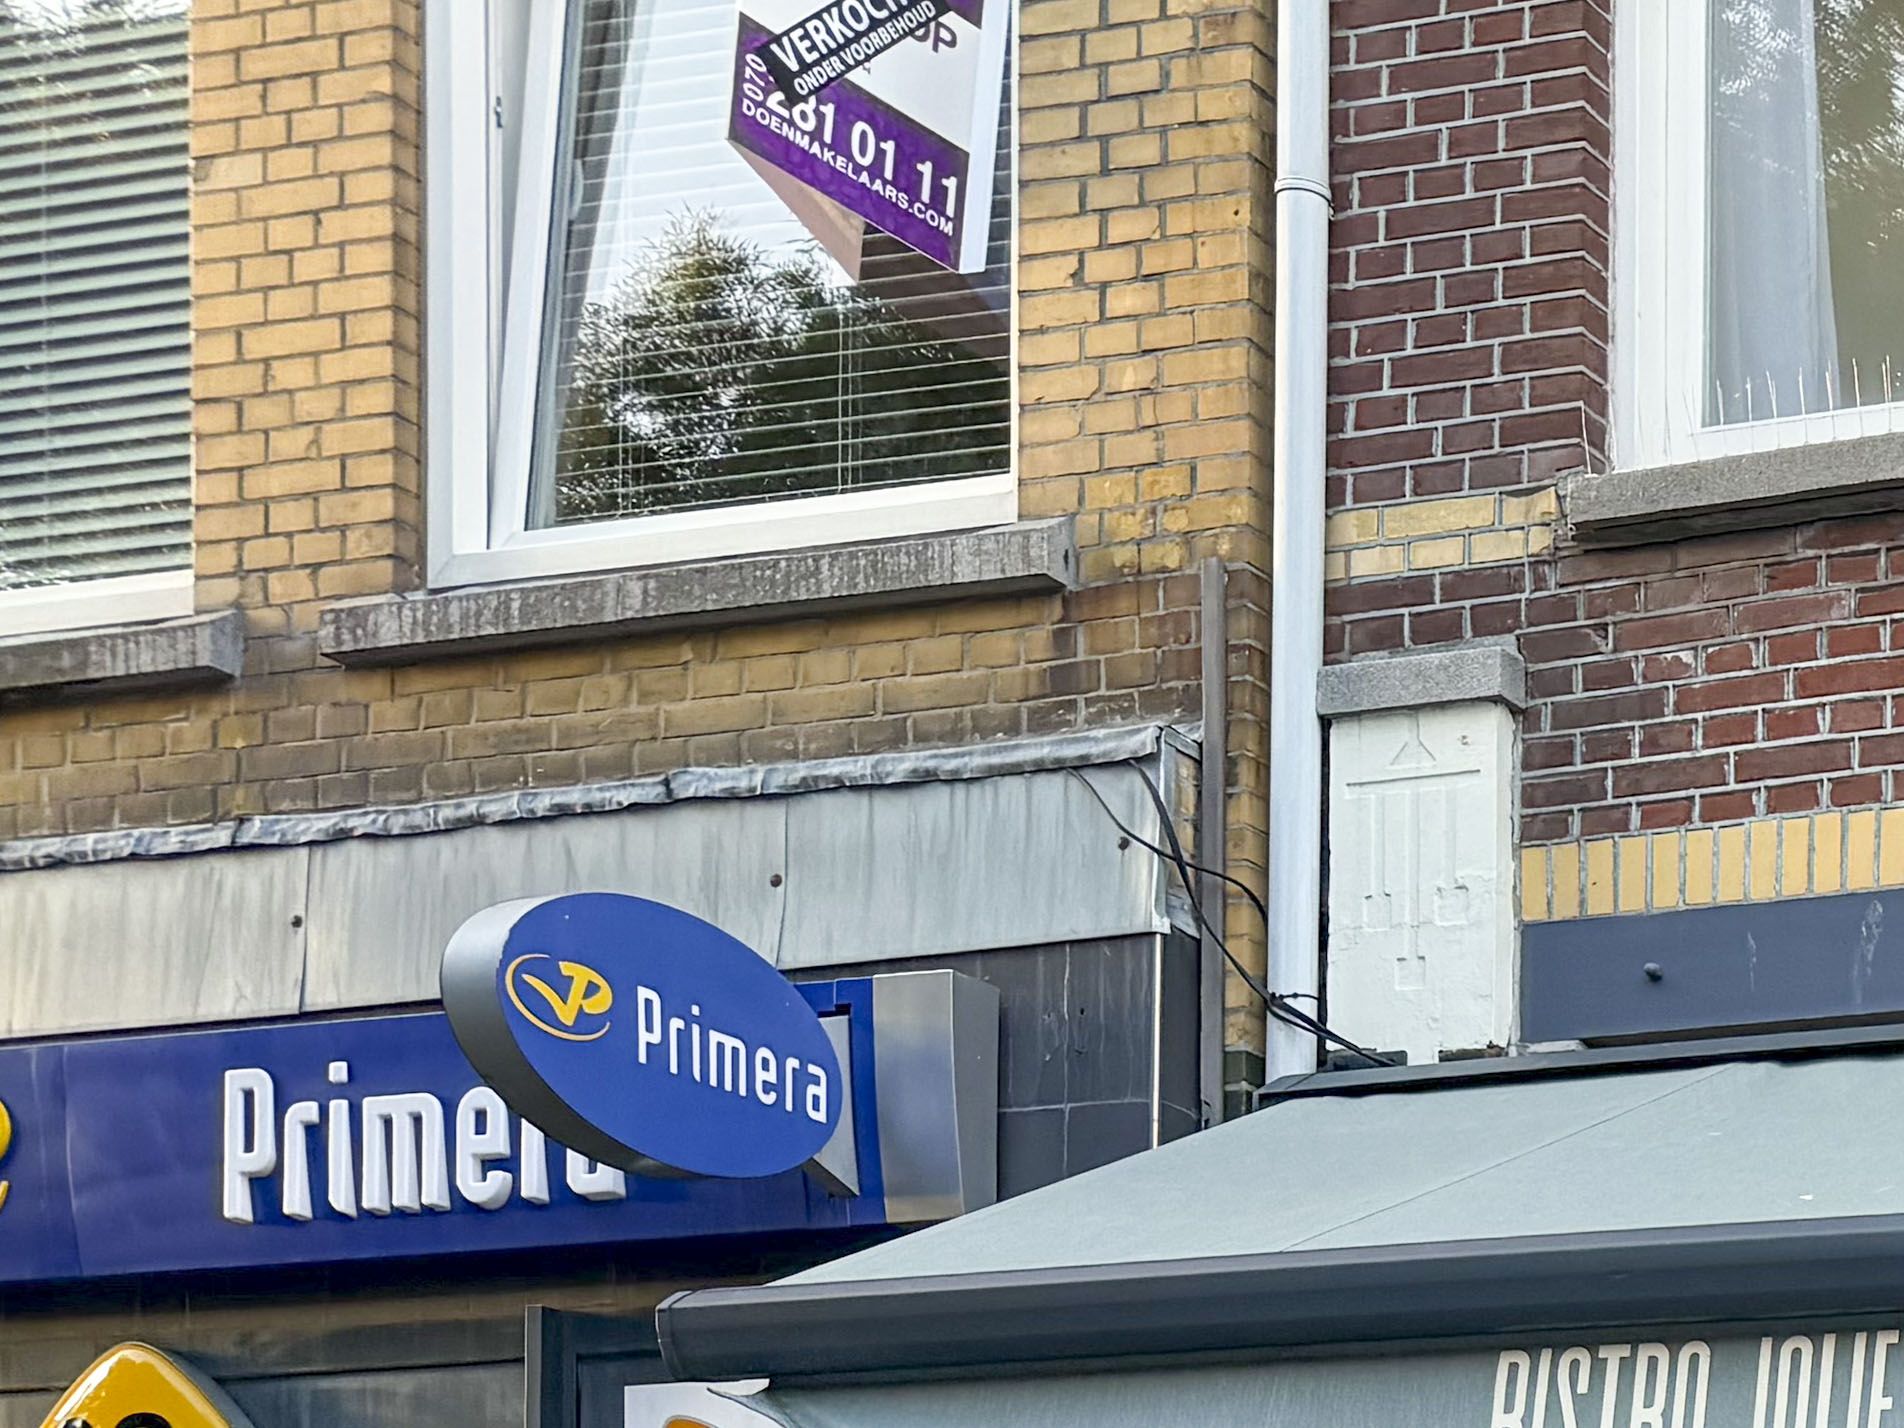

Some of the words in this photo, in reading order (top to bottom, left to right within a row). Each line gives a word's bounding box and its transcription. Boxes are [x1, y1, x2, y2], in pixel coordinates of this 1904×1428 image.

[742, 53, 767, 102] 070
[794, 57, 846, 96] ONDER
[842, 0, 937, 67] VOORBEHOUD
[742, 98, 954, 237] DOENMAKELAARS.COM
[851, 121, 896, 181] 01
[916, 161, 958, 218] 11
[637, 985, 829, 1125] Primera
